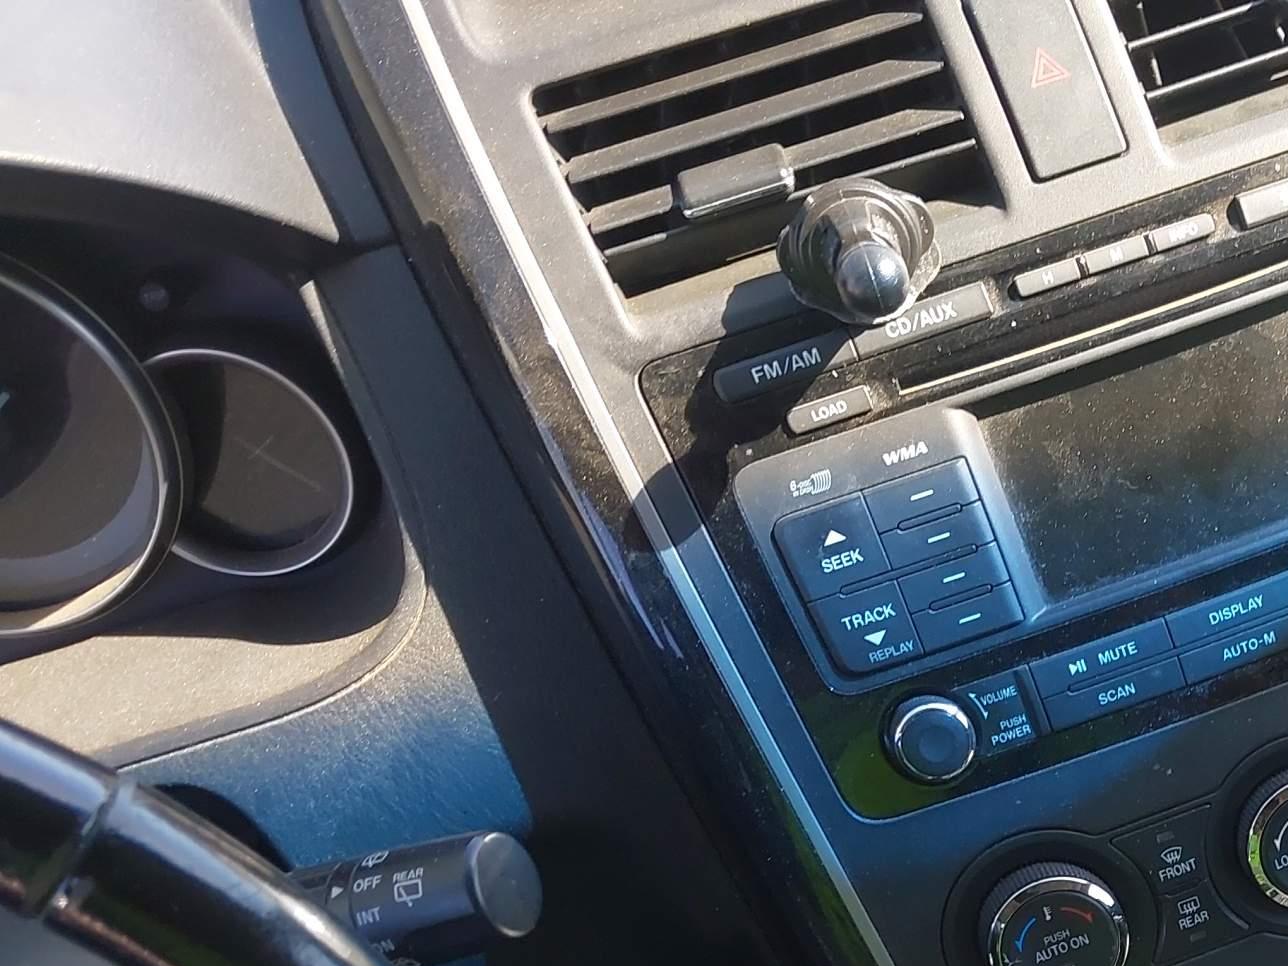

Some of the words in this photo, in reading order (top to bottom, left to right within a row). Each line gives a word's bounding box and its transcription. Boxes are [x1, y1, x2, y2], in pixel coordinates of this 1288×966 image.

[884, 302, 958, 339] CD/AUX
[751, 347, 822, 385] FM/AM
[810, 400, 848, 422] LOAD
[882, 440, 929, 467] WMA
[821, 548, 864, 574] SEEK
[841, 603, 896, 632] TRACK
[1209, 594, 1264, 625] DISPLAY
[869, 640, 914, 663] REPLAY
[1098, 641, 1138, 667] MUTE
[1222, 631, 1277, 662] AUTO-M
[979, 685, 1018, 706] VOLUME
[1098, 683, 1136, 706] SCAN
[1000, 713, 1027, 731] PUSH
[991, 724, 1032, 746] POWER
[392, 868, 424, 884] REAR
[1158, 857, 1198, 882] FRONT
[352, 874, 383, 893] OFF
[356, 907, 381, 927] INT
[1178, 910, 1210, 930] REAR
[1035, 942, 1068, 964] AUTO
[1069, 933, 1090, 950] ON
[1043, 929, 1071, 946] PUSH
